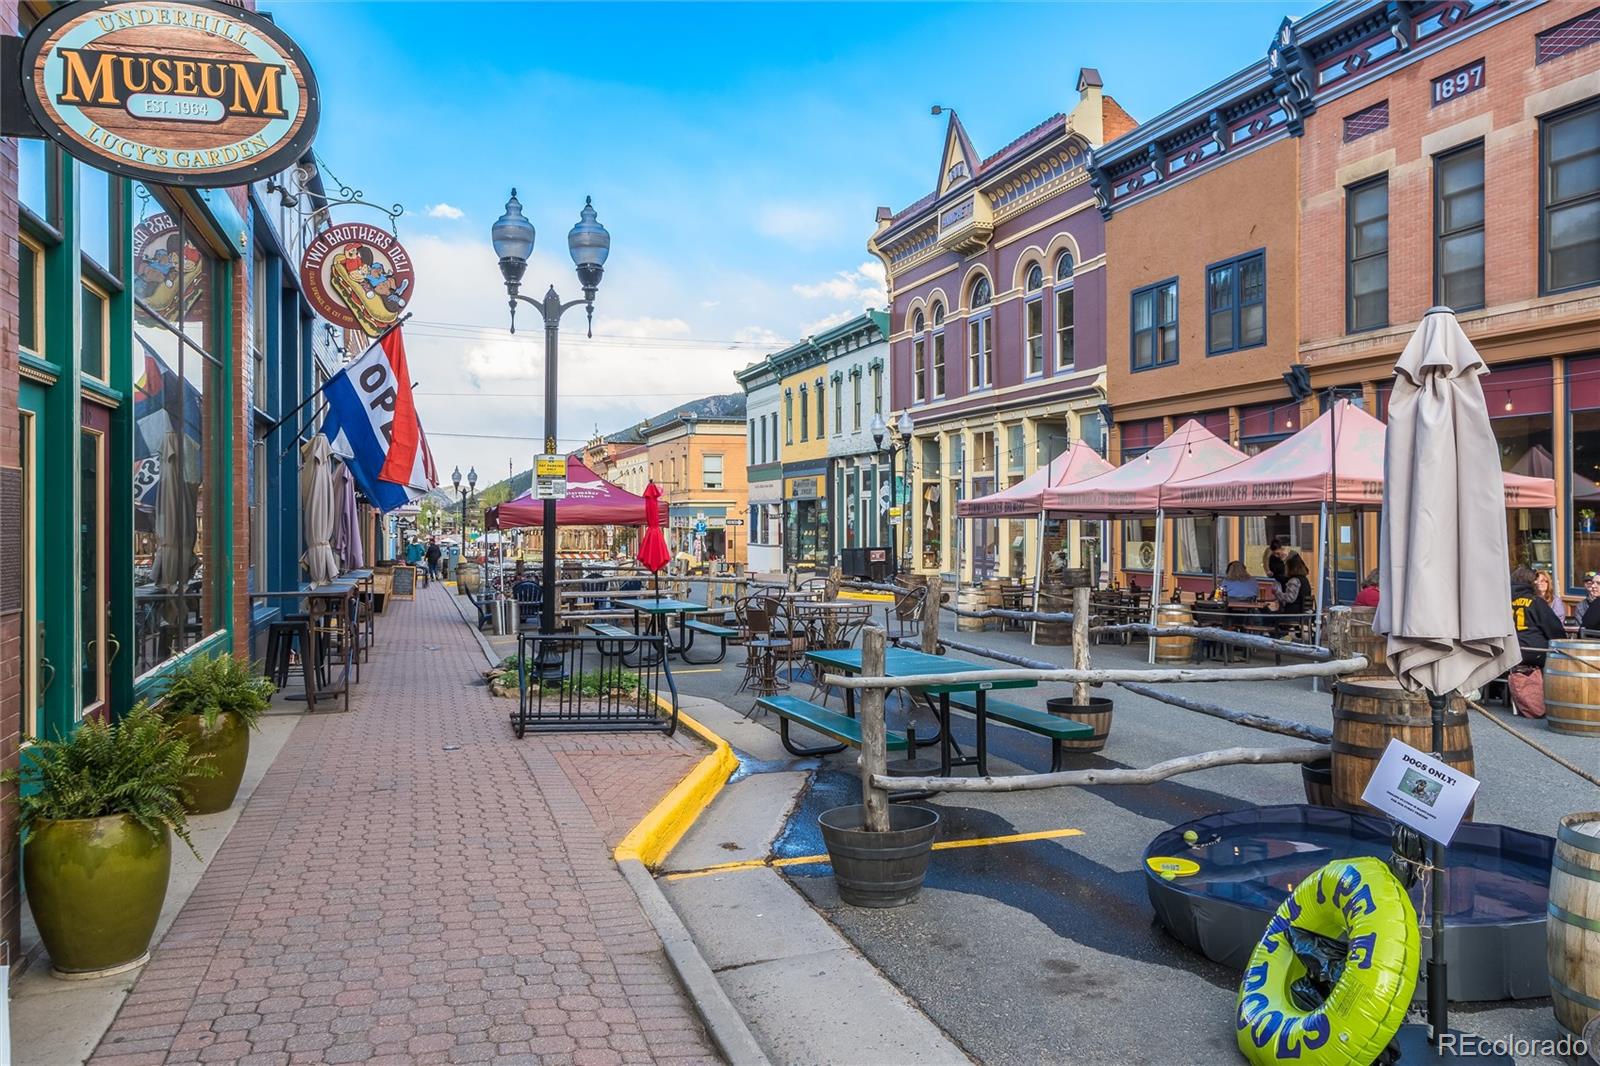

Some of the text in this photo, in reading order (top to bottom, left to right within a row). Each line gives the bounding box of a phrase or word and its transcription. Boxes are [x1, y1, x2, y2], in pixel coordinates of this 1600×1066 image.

[96, 7, 250, 46] UNDERHILL
[61, 49, 283, 115] MUSEUM
[1435, 65, 1483, 101] 1897
[144, 99, 209, 116] EST. 1964
[86, 126, 269, 168] LUCY'S GARDEN
[305, 226, 410, 273] TWO BROTHERS DELI
[1181, 481, 1294, 503] TOMMYKNOCKER BREWERY
[1402, 754, 1457, 786] DOGS ONLY!
[1237, 960, 1331, 1060] POOLS
